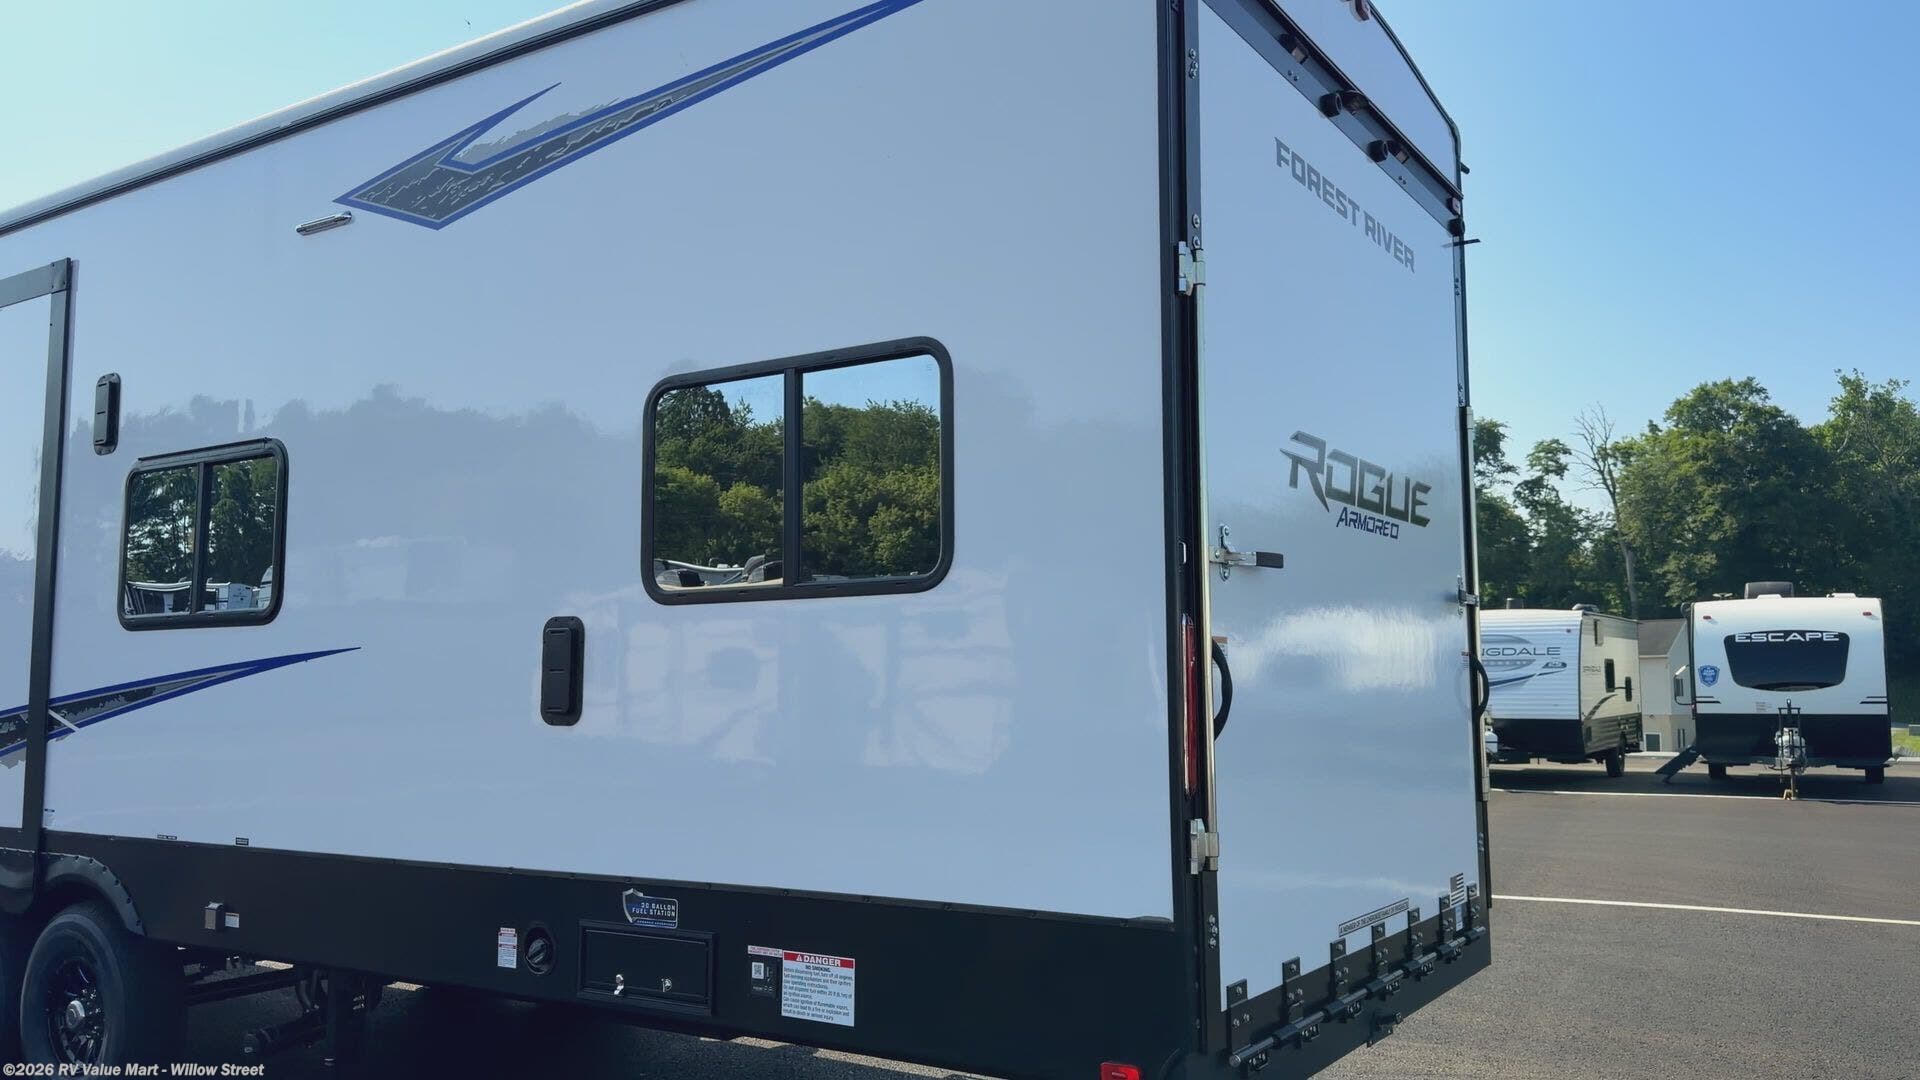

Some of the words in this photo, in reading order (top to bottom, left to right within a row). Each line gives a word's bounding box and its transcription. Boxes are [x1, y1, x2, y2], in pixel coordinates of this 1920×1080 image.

[1274, 136, 1360, 226] FOREST
[1363, 210, 1415, 274] RIVER
[1280, 430, 1432, 527] ROGUE
[1336, 506, 1399, 539] ARMORED
[1735, 632, 1839, 642] ESCAPE
[650, 909, 676, 917] STATION
[804, 955, 841, 966] DANGER
